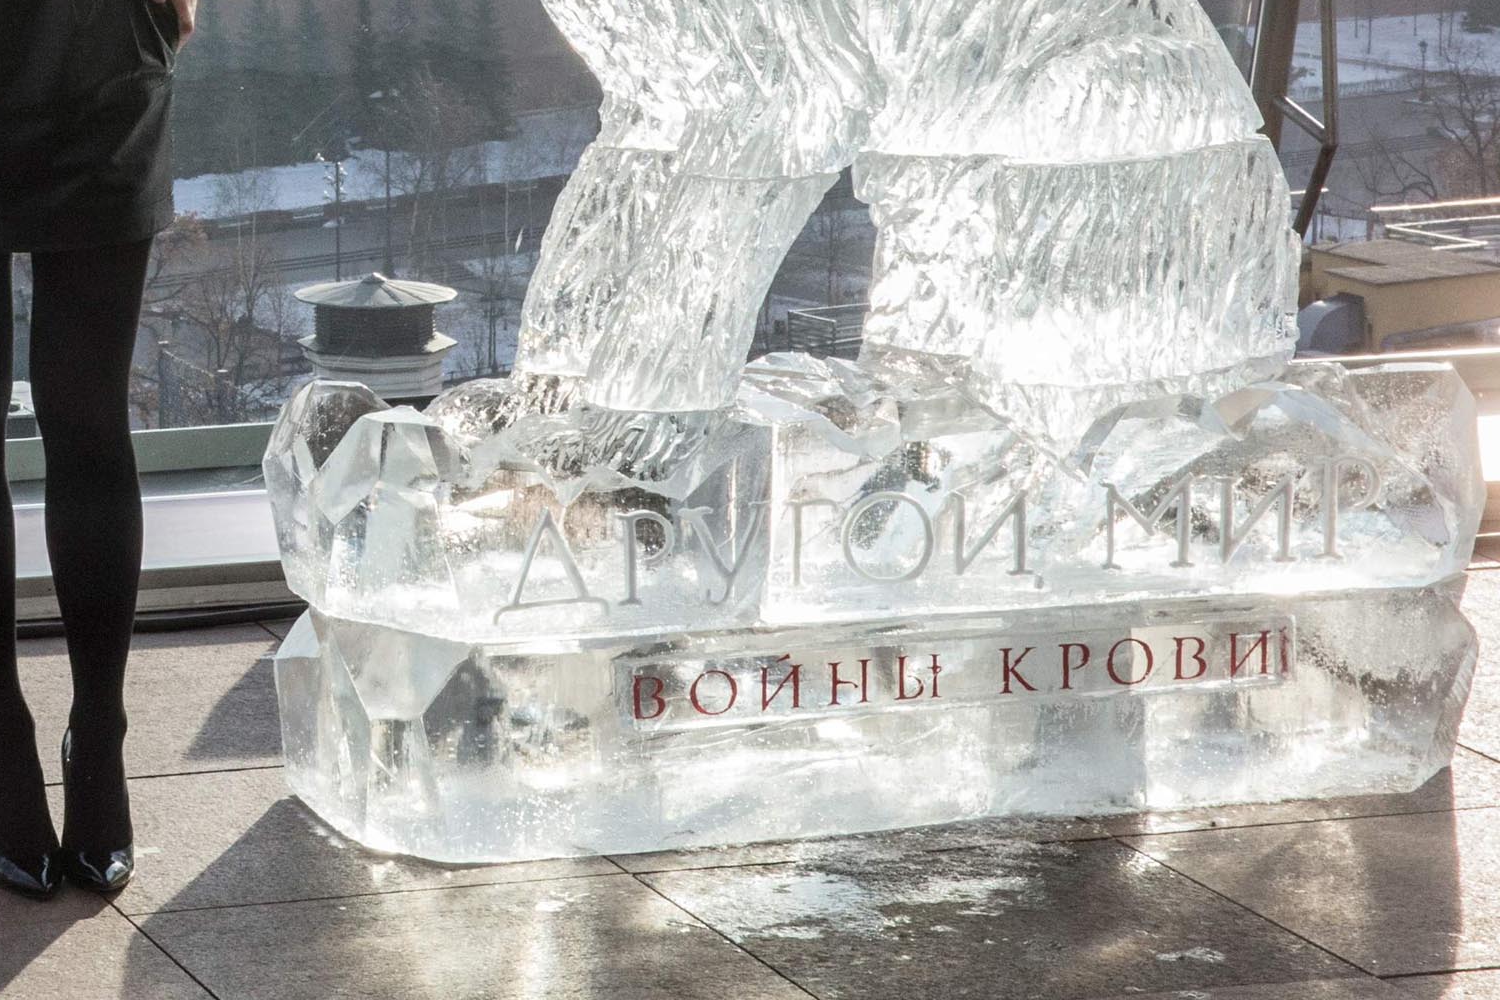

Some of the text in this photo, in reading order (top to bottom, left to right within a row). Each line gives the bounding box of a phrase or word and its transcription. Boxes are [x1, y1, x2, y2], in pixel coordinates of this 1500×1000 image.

[1100, 456, 1381, 570] МИР
[632, 629, 1271, 721] ВОЙНЫ КРОВИ
